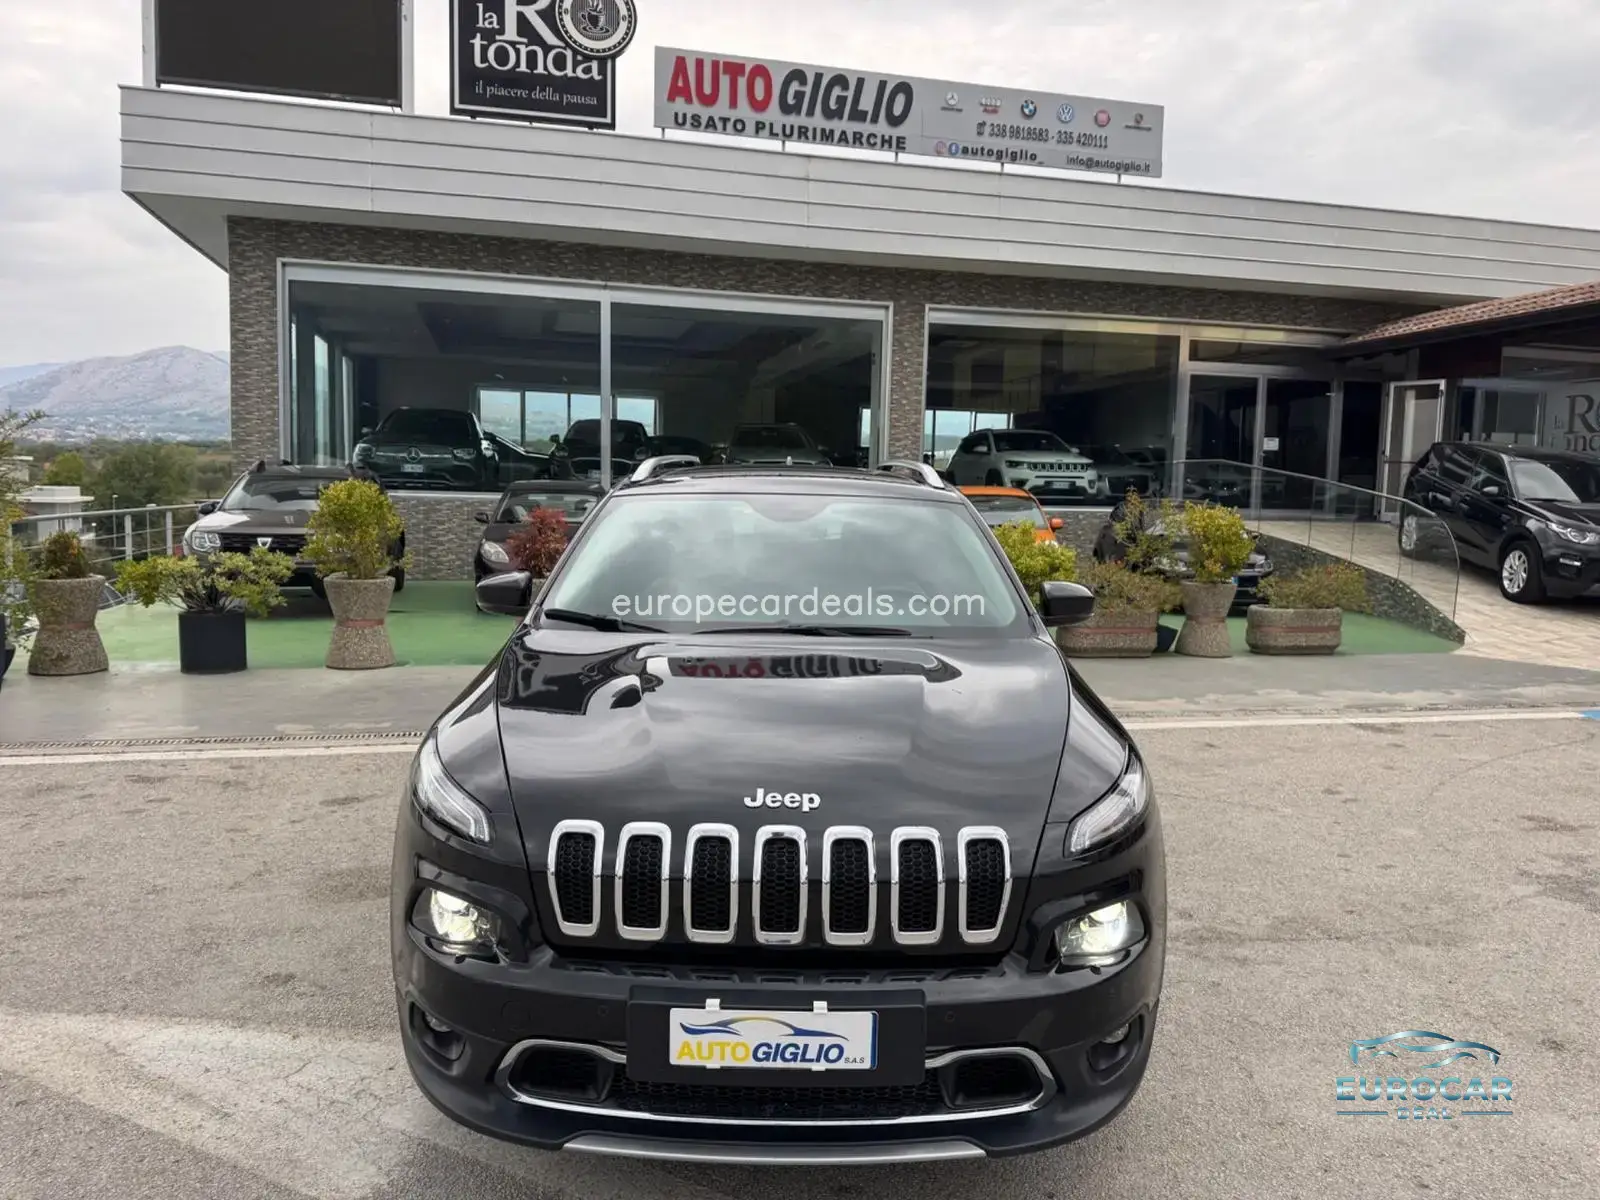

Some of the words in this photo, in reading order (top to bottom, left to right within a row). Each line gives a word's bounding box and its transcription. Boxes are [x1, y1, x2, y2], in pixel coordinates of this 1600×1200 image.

[475, 3, 500, 29] la
[469, 32, 603, 80] tonda
[475, 80, 483, 95] il
[486, 83, 529, 99] piacere
[532, 86, 560, 102] della
[563, 93, 598, 106] pausa
[666, 55, 773, 113] AUTO
[778, 68, 914, 128] GIGLIO
[674, 111, 746, 133] USATO
[755, 120, 907, 150] PLURIMARCHE
[988, 122, 1007, 138] 338
[1056, 130, 1074, 145] 335
[1076, 132, 1108, 149] 420111
[1066, 155, 1150, 173] info@autogiglio.it
[743, 787, 821, 812] Jeep
[676, 1040, 750, 1063] AUTO
[752, 1041, 845, 1064] GIGLIO
